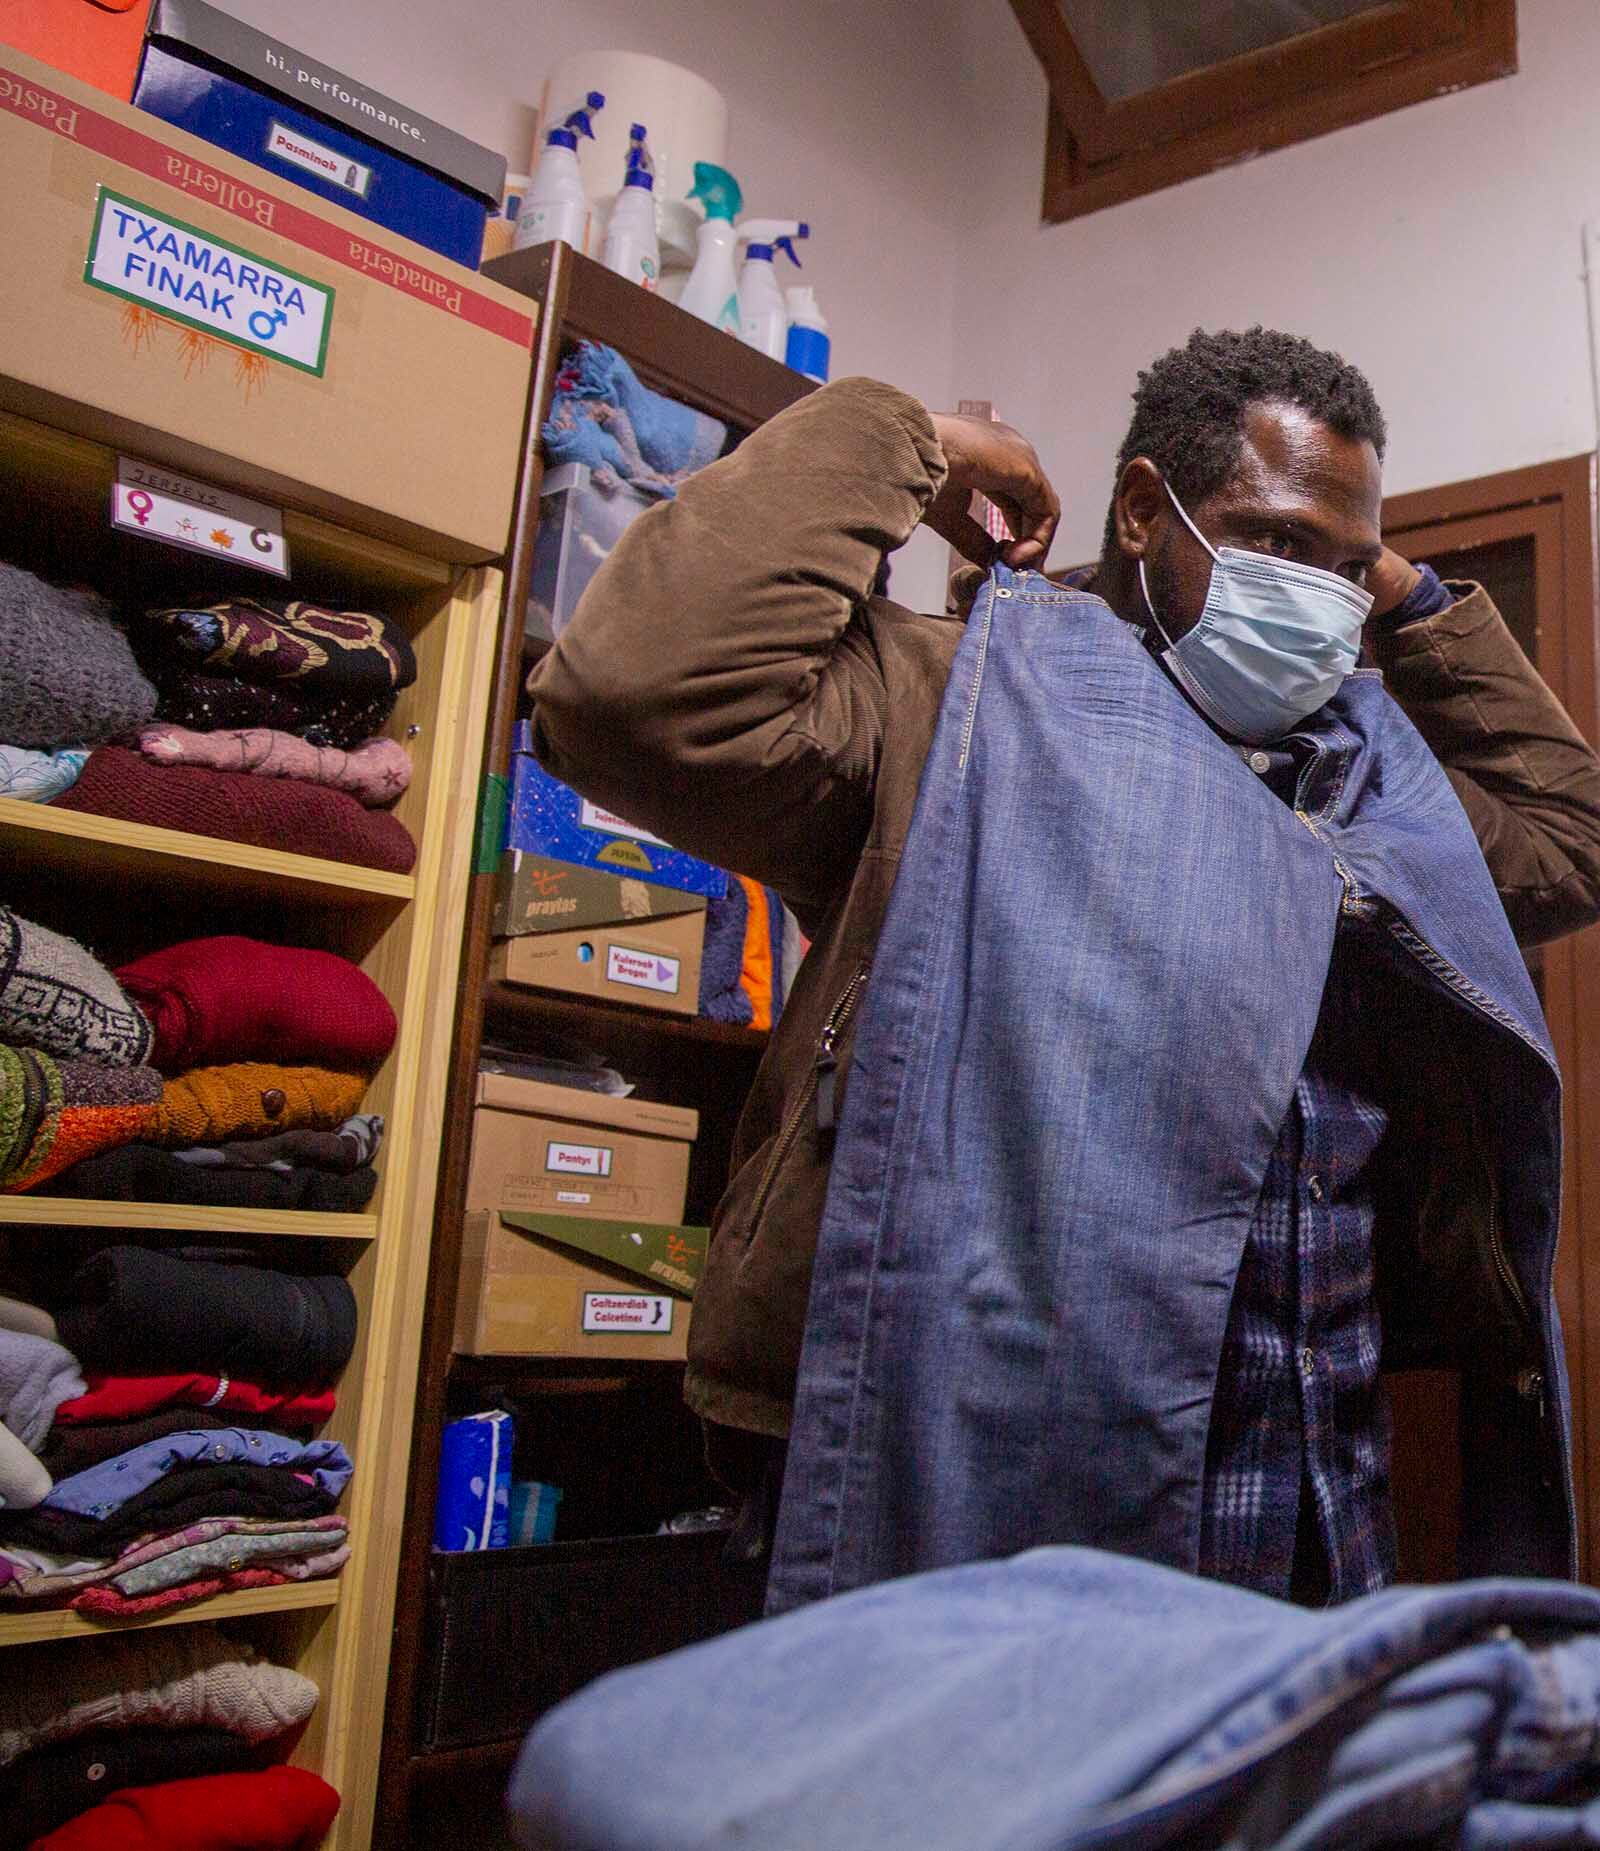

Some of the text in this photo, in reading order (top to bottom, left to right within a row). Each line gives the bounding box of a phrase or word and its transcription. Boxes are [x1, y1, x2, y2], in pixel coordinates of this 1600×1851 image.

[265, 48, 428, 143] hi. performance.
[114, 208, 306, 315] TXAMARRA
[123, 251, 234, 320] FINAK
[132, 468, 218, 505] JERSEYS
[250, 528, 273, 553] G
